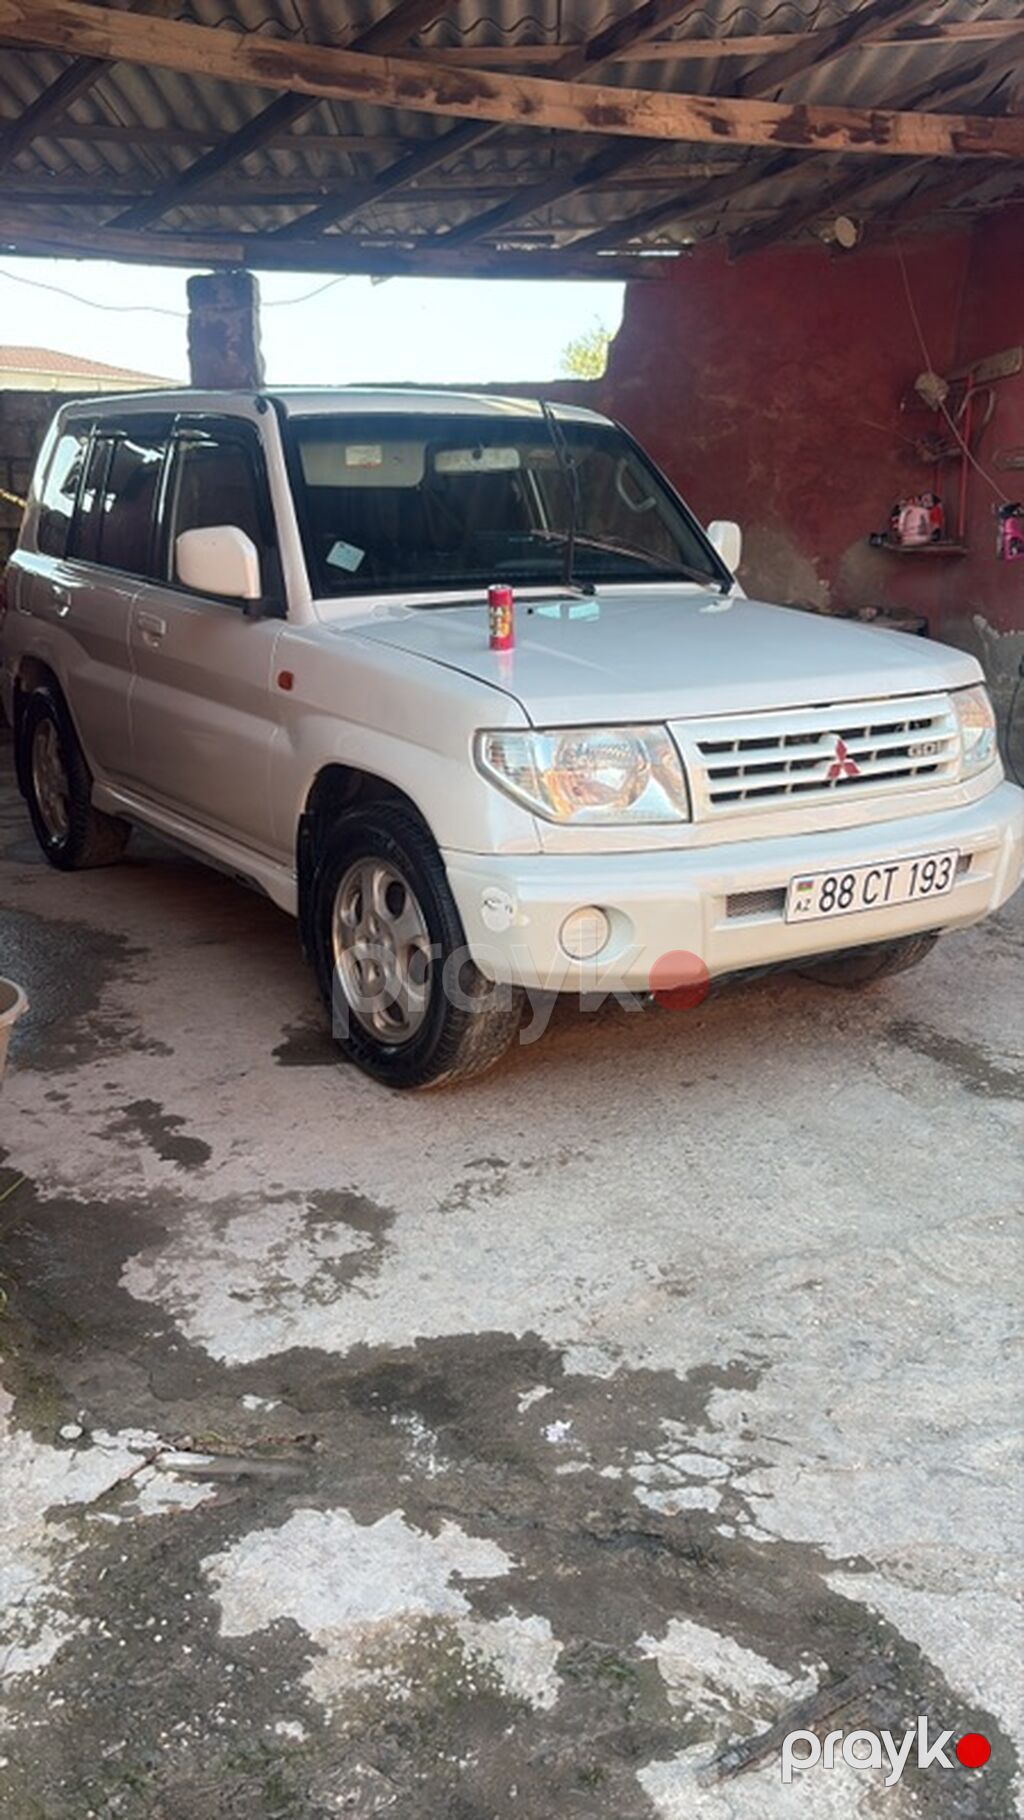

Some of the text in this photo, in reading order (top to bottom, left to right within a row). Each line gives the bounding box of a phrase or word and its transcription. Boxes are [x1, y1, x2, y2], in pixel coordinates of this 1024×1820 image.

[819, 857, 951, 912] 88 CT 193
[794, 899, 811, 912] AZ
